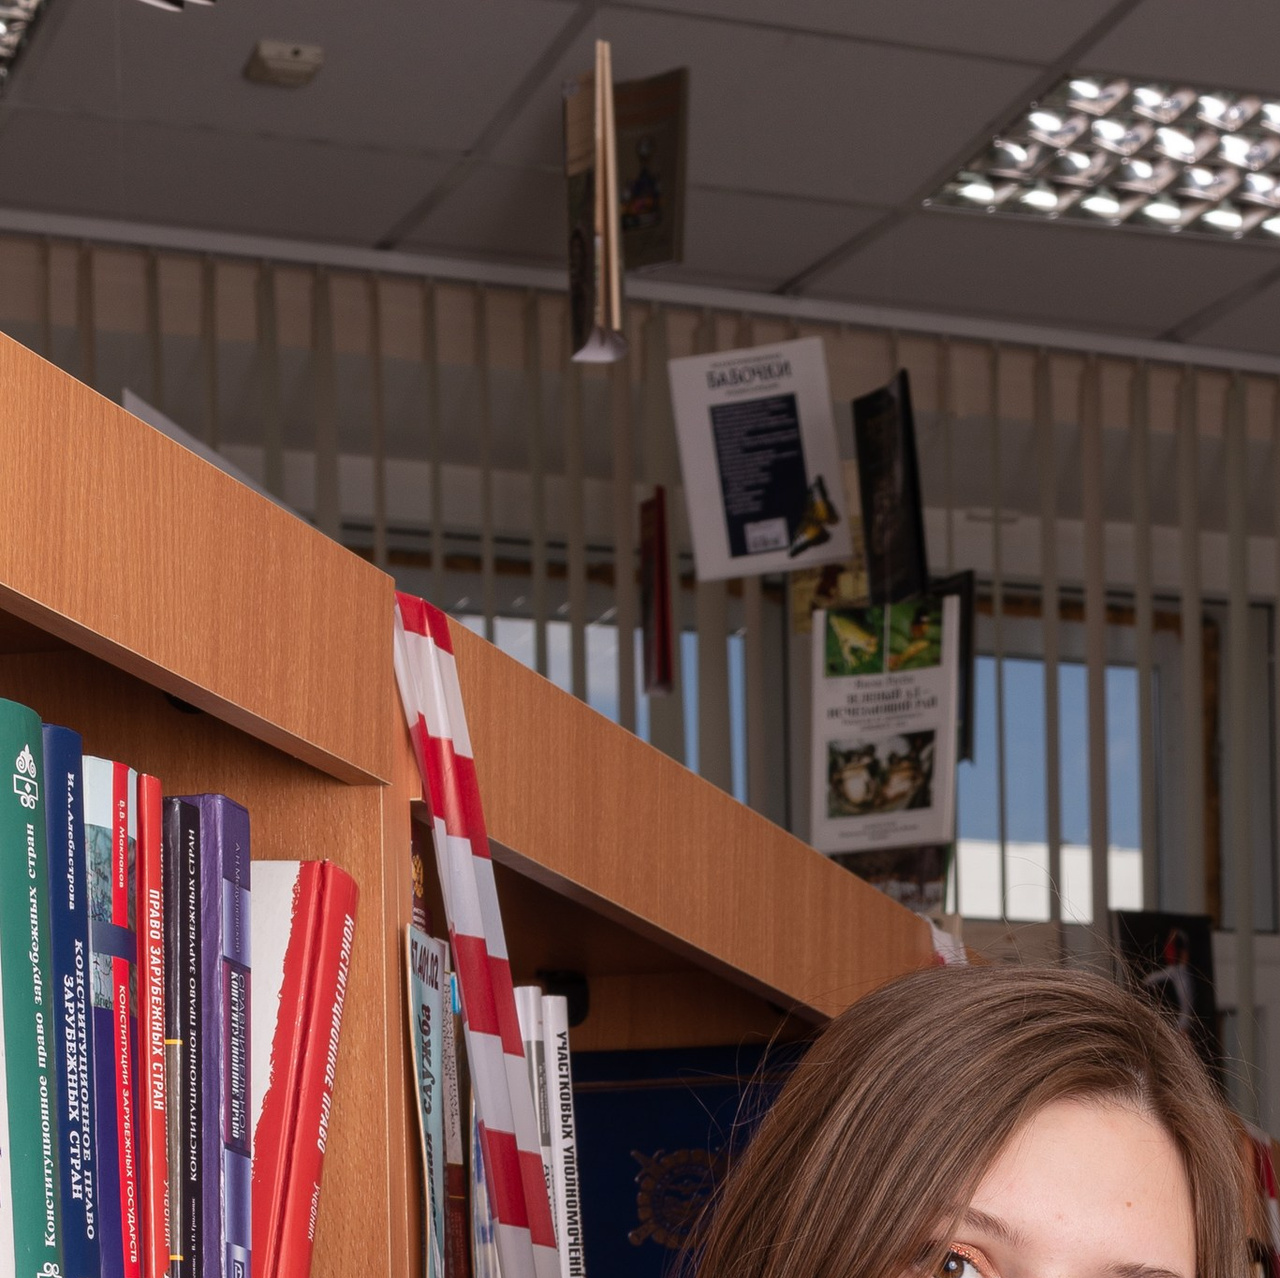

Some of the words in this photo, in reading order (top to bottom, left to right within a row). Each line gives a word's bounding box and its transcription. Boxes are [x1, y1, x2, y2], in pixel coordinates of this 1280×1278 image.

[26, 823, 36, 879] стран
[28, 886, 43, 1006] зарубежных
[149, 888, 161, 940] ПРАВО
[188, 883, 196, 976] ЗАРУБЕЖНЫХ
[35, 1013, 48, 1068] право
[63, 975, 79, 1121] ЗАРУБЕЖНЫХ
[119, 985, 130, 1085] КОНСТИТУЦИИ
[150, 944, 164, 1057] ЗАРУБЕЖНЫХ
[230, 971, 240, 1096] КОНСТИТУЦИОННОЕ
[324, 913, 354, 1091] КОНСТИТУЦИОННОЕ
[74, 938, 91, 1161] КОНСТИТУЦИОННОЕ
[83, 1166, 95, 1240] ПРАВО
[152, 1062, 165, 1111] СТРАН
[189, 1030, 197, 1182] КОНСТИТУЦИОННОЕ
[418, 1003, 436, 1115] служба
[556, 1031, 574, 1139] УЧАСТКОВЫХ
[37, 1075, 56, 1248] Конституционное
[69, 1130, 83, 1200] СТРАН
[123, 1089, 133, 1177] ЗАРУБЕЖНЫХ
[231, 1098, 240, 1139] ПРАВО
[317, 1090, 335, 1155] ПРАВО
[127, 1180, 137, 1264] ГОСУДАРСТВ
